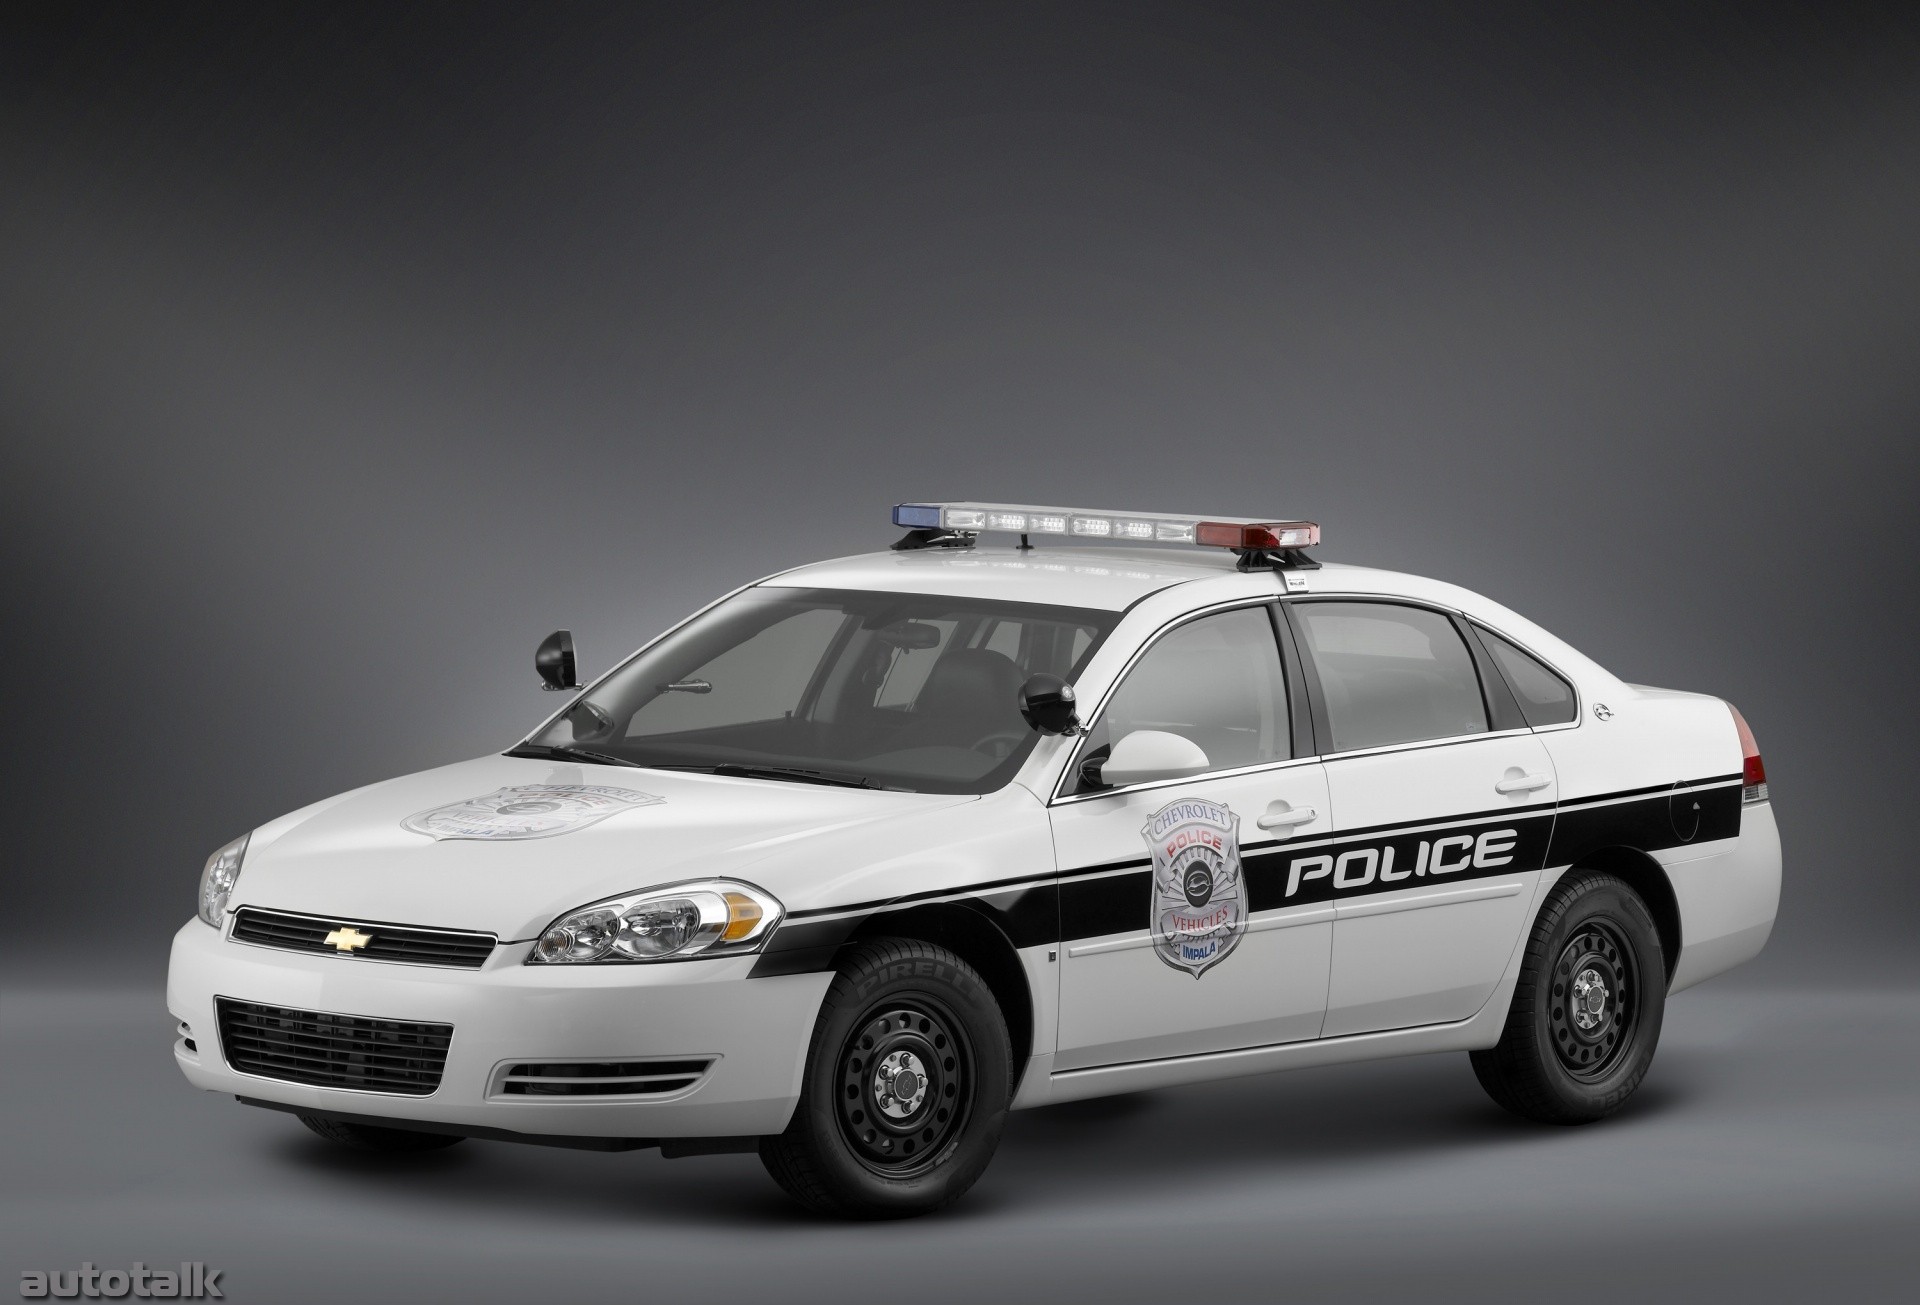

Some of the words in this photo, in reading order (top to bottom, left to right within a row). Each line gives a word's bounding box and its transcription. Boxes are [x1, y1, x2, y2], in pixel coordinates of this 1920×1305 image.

[1154, 804, 1226, 835] CHEVROLET
[1166, 830, 1223, 858] POLICE
[1284, 829, 1518, 898] POLICE
[1171, 905, 1228, 932] VEHICLES
[1182, 941, 1216, 960] IMPALA
